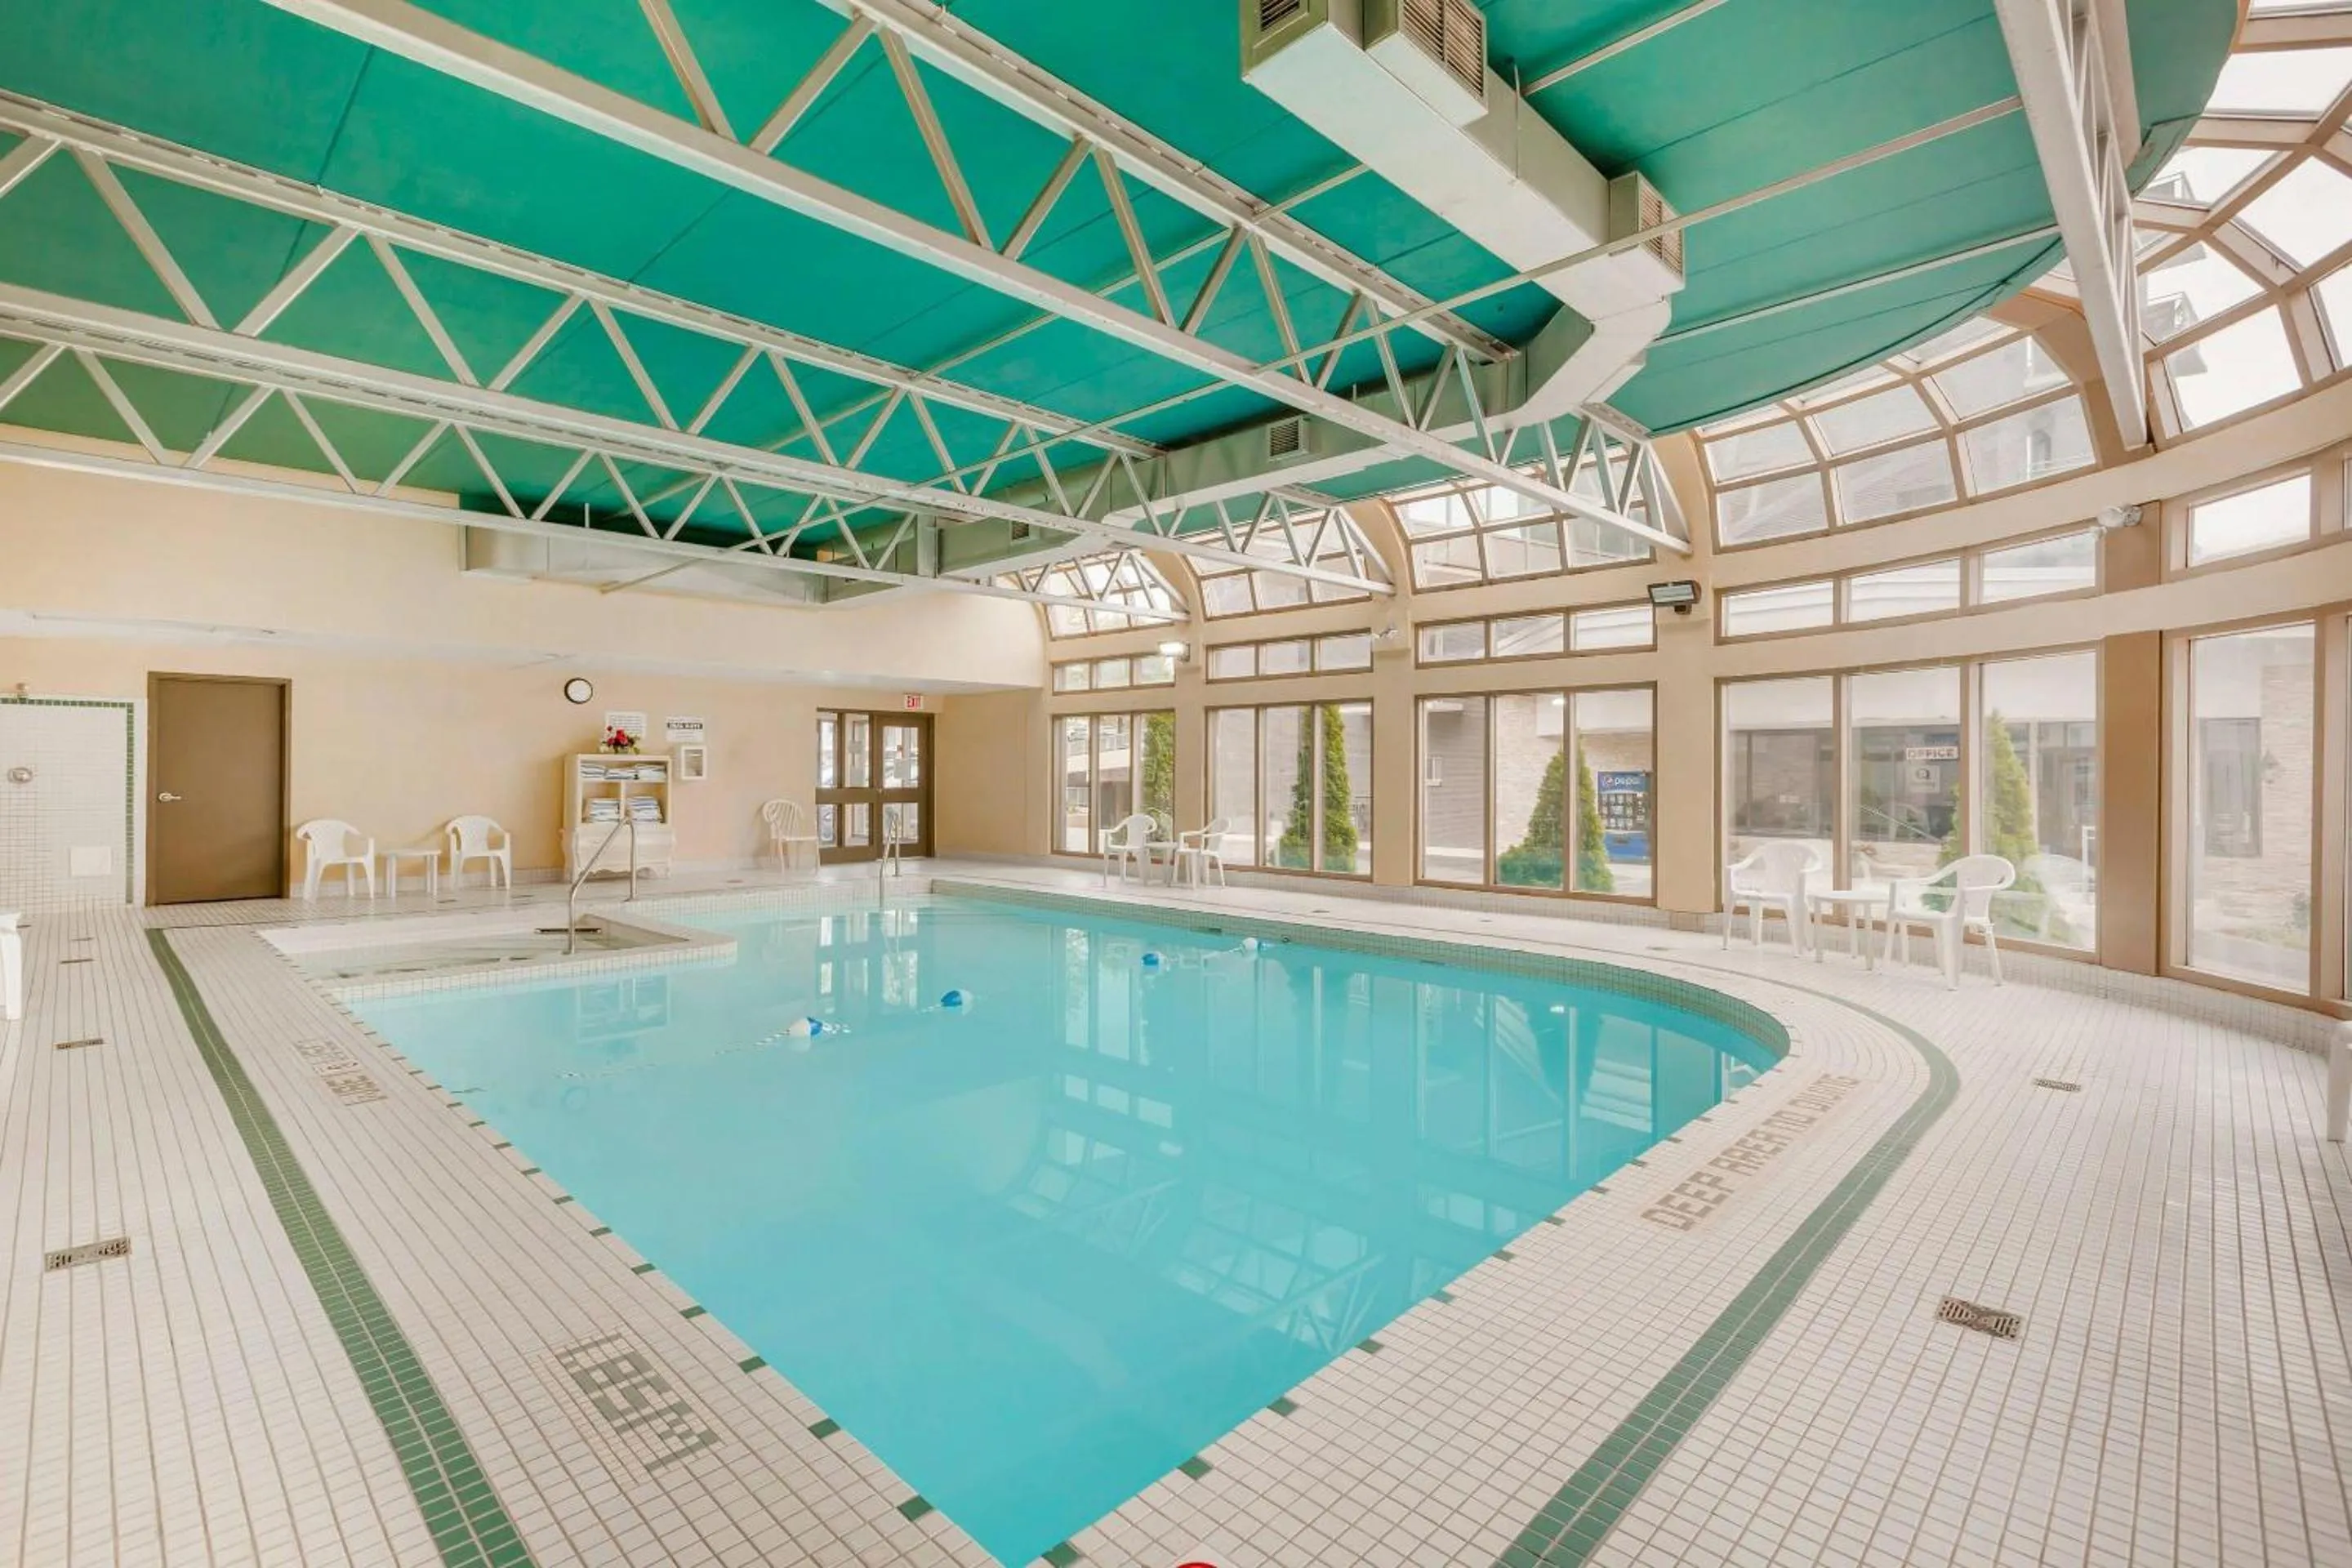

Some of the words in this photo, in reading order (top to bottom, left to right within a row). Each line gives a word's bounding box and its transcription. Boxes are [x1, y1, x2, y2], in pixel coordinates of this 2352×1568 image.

[1908, 748, 1955, 758] OFFICE
[1641, 1171, 1734, 1232] DEEP
[1708, 1129, 1793, 1176] AREA
